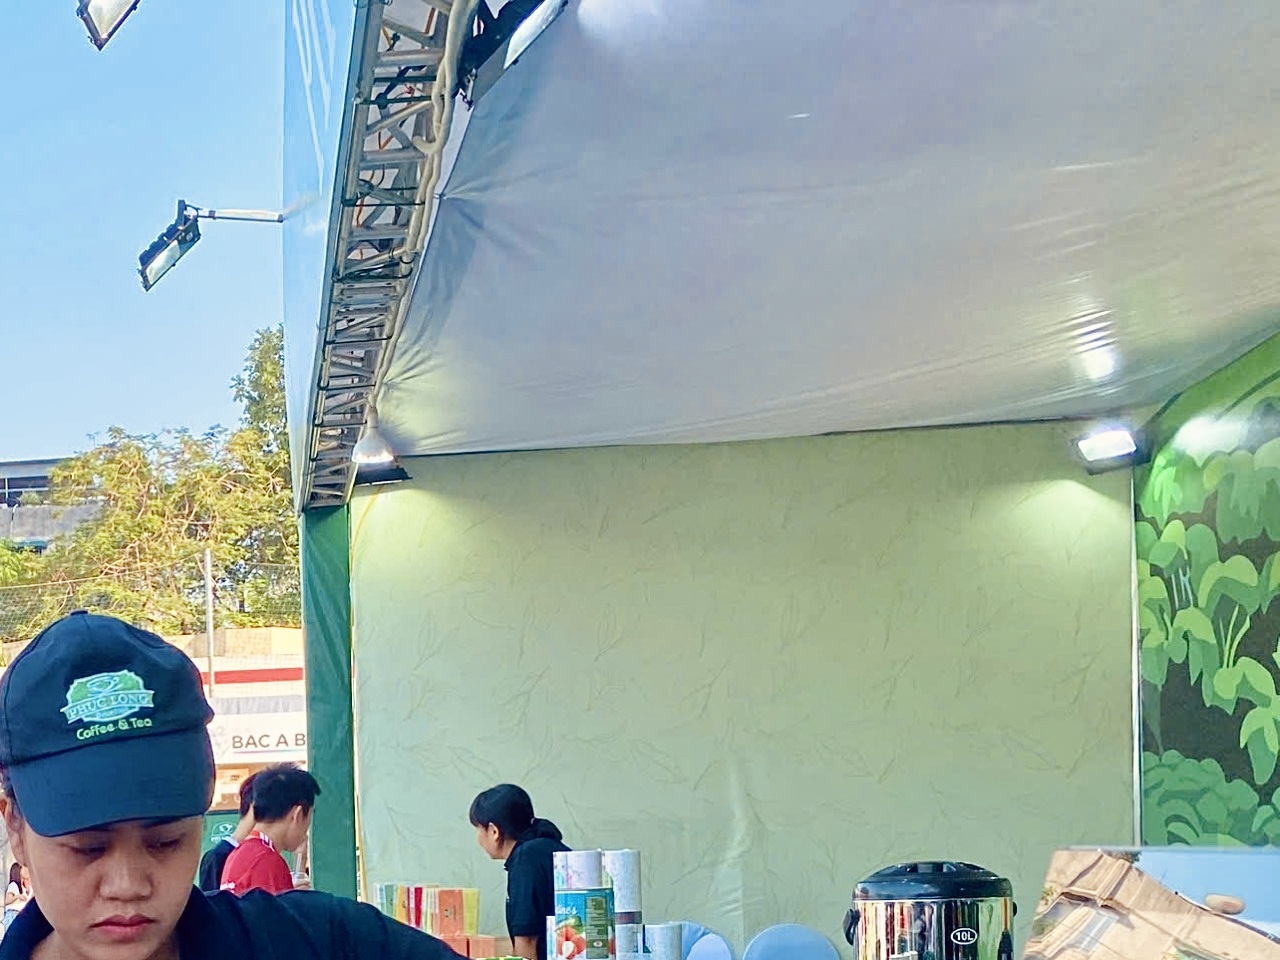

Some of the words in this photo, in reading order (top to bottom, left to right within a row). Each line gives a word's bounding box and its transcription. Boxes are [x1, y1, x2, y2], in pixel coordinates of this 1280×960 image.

[110, 693, 148, 705] LONG
[76, 723, 115, 740] Coffee
[118, 719, 128, 730] &
[129, 718, 152, 728] Tea
[232, 734, 270, 749] BAC
[276, 733, 289, 748] A
[955, 931, 974, 941] 10L
